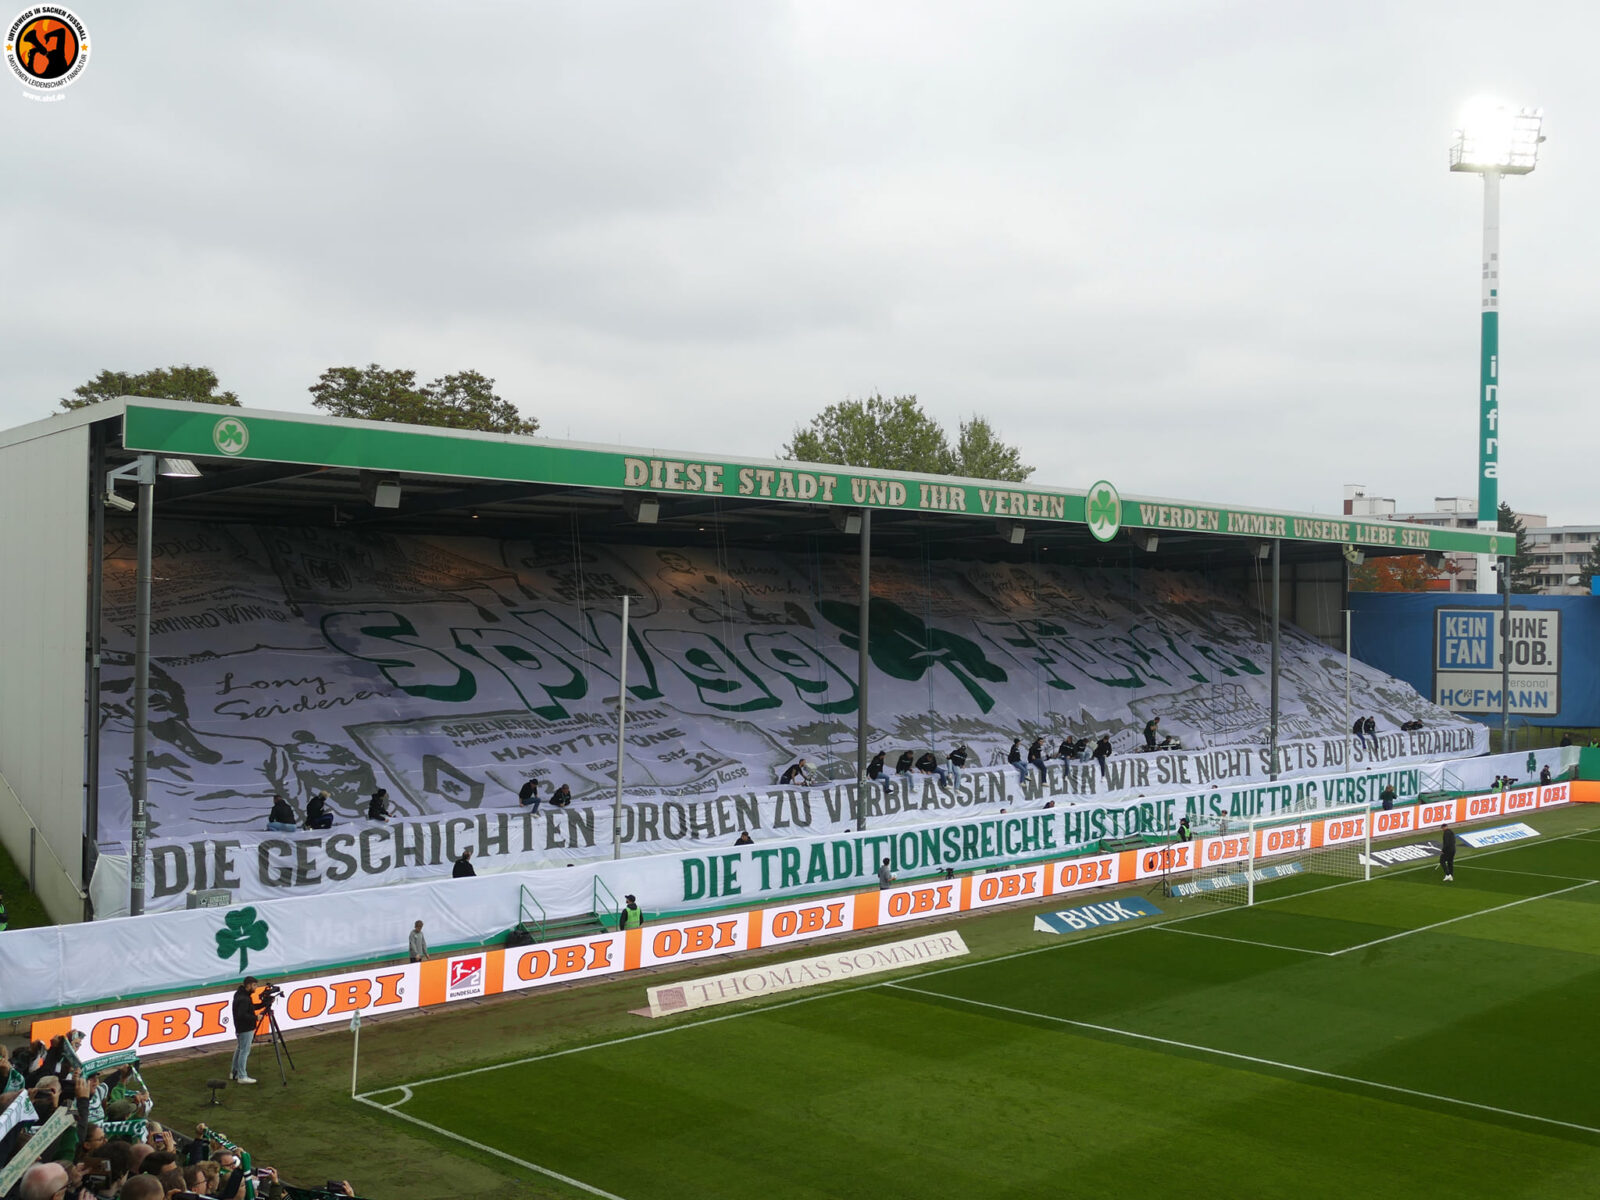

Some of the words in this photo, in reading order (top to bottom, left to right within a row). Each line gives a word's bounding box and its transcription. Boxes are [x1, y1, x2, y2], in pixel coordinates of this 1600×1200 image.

[1485, 355, 1498, 479] infra
[624, 457, 724, 493] DIESE
[739, 468, 838, 502] STADT
[851, 478, 907, 506] UND
[919, 484, 966, 512] IHR
[979, 489, 1065, 519] VEREIN
[1139, 504, 1219, 531] WERDEN
[1227, 511, 1286, 537] IMMER
[1293, 518, 1350, 543] UNSERE
[1356, 525, 1396, 546] LIEBE
[1401, 529, 1430, 547] SEIN
[1445, 616, 1487, 638] KEIN
[1445, 639, 1486, 665] FAN
[1499, 640, 1552, 666] JOB.
[1507, 680, 1549, 689] ersonal
[1441, 689, 1548, 708] HOFMANN
[657, 748, 688, 763] Sitz
[684, 752, 723, 773] 21
[717, 766, 749, 784] Kasse
[1508, 789, 1534, 809] OBI
[1543, 784, 1567, 803] OBI
[149, 840, 241, 898] DIE
[258, 806, 596, 888] GESCHICHTEN
[612, 795, 762, 844] DROHEN
[766, 790, 812, 828] ZU
[824, 771, 1014, 824] VERBLASSEN,
[1022, 763, 1096, 802] WENN
[1103, 756, 1150, 790] WIR
[1157, 753, 1191, 784] SIE
[1195, 747, 1254, 785] NICHT
[1322, 738, 1364, 768] AUFS
[1366, 733, 1408, 763] NEUE
[1410, 727, 1475, 756] ERZÄHLEN
[1423, 804, 1453, 824] OBI
[1470, 796, 1498, 816] OBI
[1329, 819, 1364, 840] OBI
[1378, 810, 1410, 832] OBI
[682, 853, 742, 902] DIE
[752, 814, 1057, 891] TRADITIONSREICHE
[1064, 798, 1176, 845] HISTORIE
[1185, 793, 1222, 828] ALS
[1231, 781, 1317, 820] AUFTRAG
[1322, 769, 1420, 804] VERSTEHEN
[1267, 827, 1306, 850] OBI
[1475, 830, 1528, 846] HOFMANN
[1142, 847, 1189, 872] OBI
[1207, 837, 1250, 861] OBI
[1060, 859, 1113, 887] OBI
[979, 871, 1037, 901] OBI
[888, 885, 952, 917] OBI
[772, 903, 845, 938] OBI
[1056, 899, 1147, 930] BVUK.
[653, 920, 738, 958] OBI
[517, 939, 613, 981] OBI
[692, 960, 832, 1002] THOMAS
[838, 936, 960, 974] SOMMER
[286, 972, 405, 1020] OBI
[450, 988, 480, 998] BUNDESLIGA
[90, 1001, 229, 1054] OBI
[102, 1121, 133, 1132] RTH
